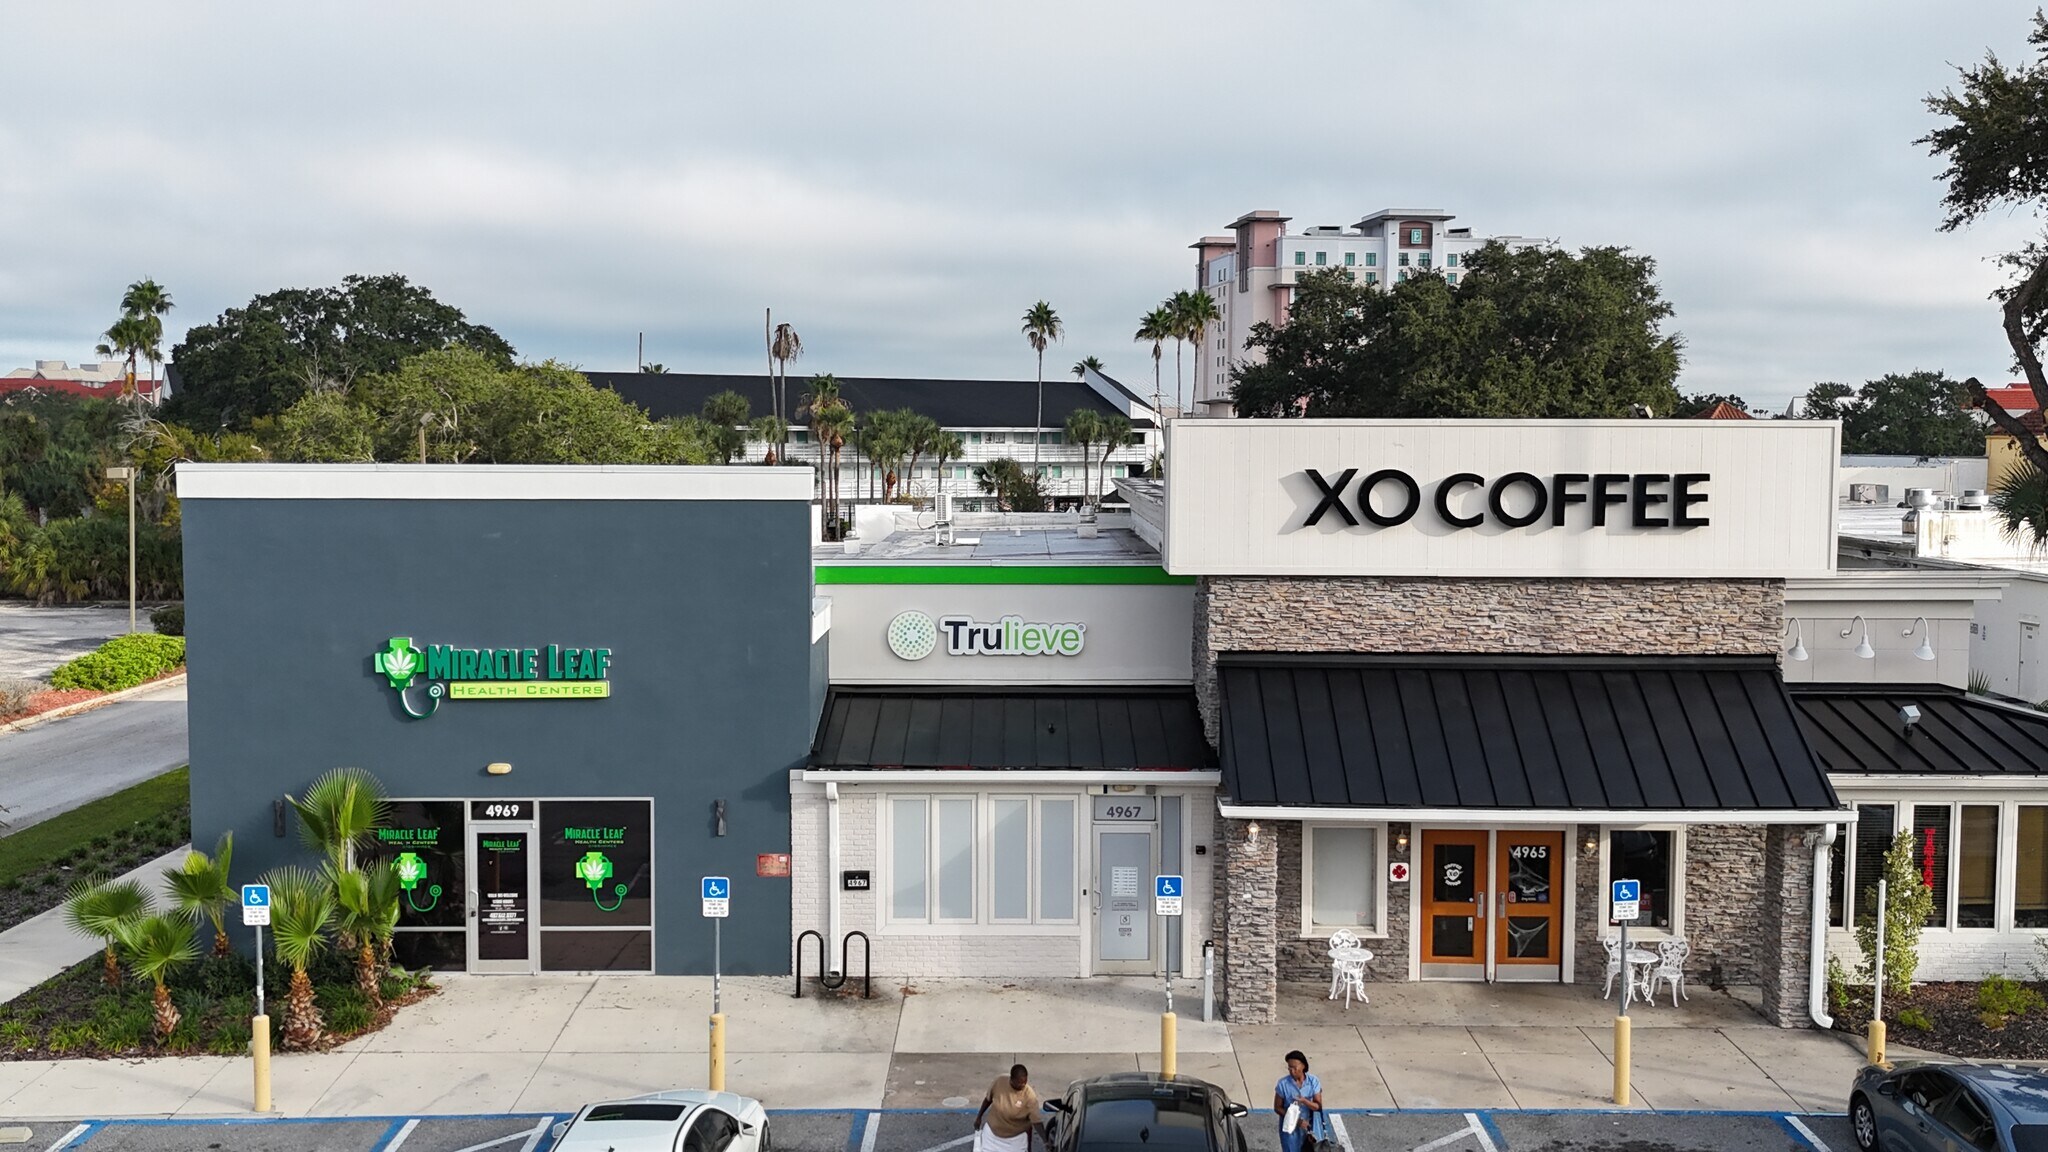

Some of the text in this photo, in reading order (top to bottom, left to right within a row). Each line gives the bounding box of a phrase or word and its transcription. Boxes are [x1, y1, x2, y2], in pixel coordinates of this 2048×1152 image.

[1303, 468, 1711, 528] XO COFFEE
[944, 620, 1080, 651] Trulieve
[428, 644, 611, 680] MIRACLE LEAF
[453, 685, 603, 695] HEALTH CENTERS
[485, 804, 520, 818] 4969
[1106, 806, 1142, 818] 4967
[378, 827, 438, 840] MIRACLE LEAF
[564, 827, 624, 839] MIRACLE LEAF
[1512, 846, 1547, 859] 4965
[847, 879, 868, 887] 4967
